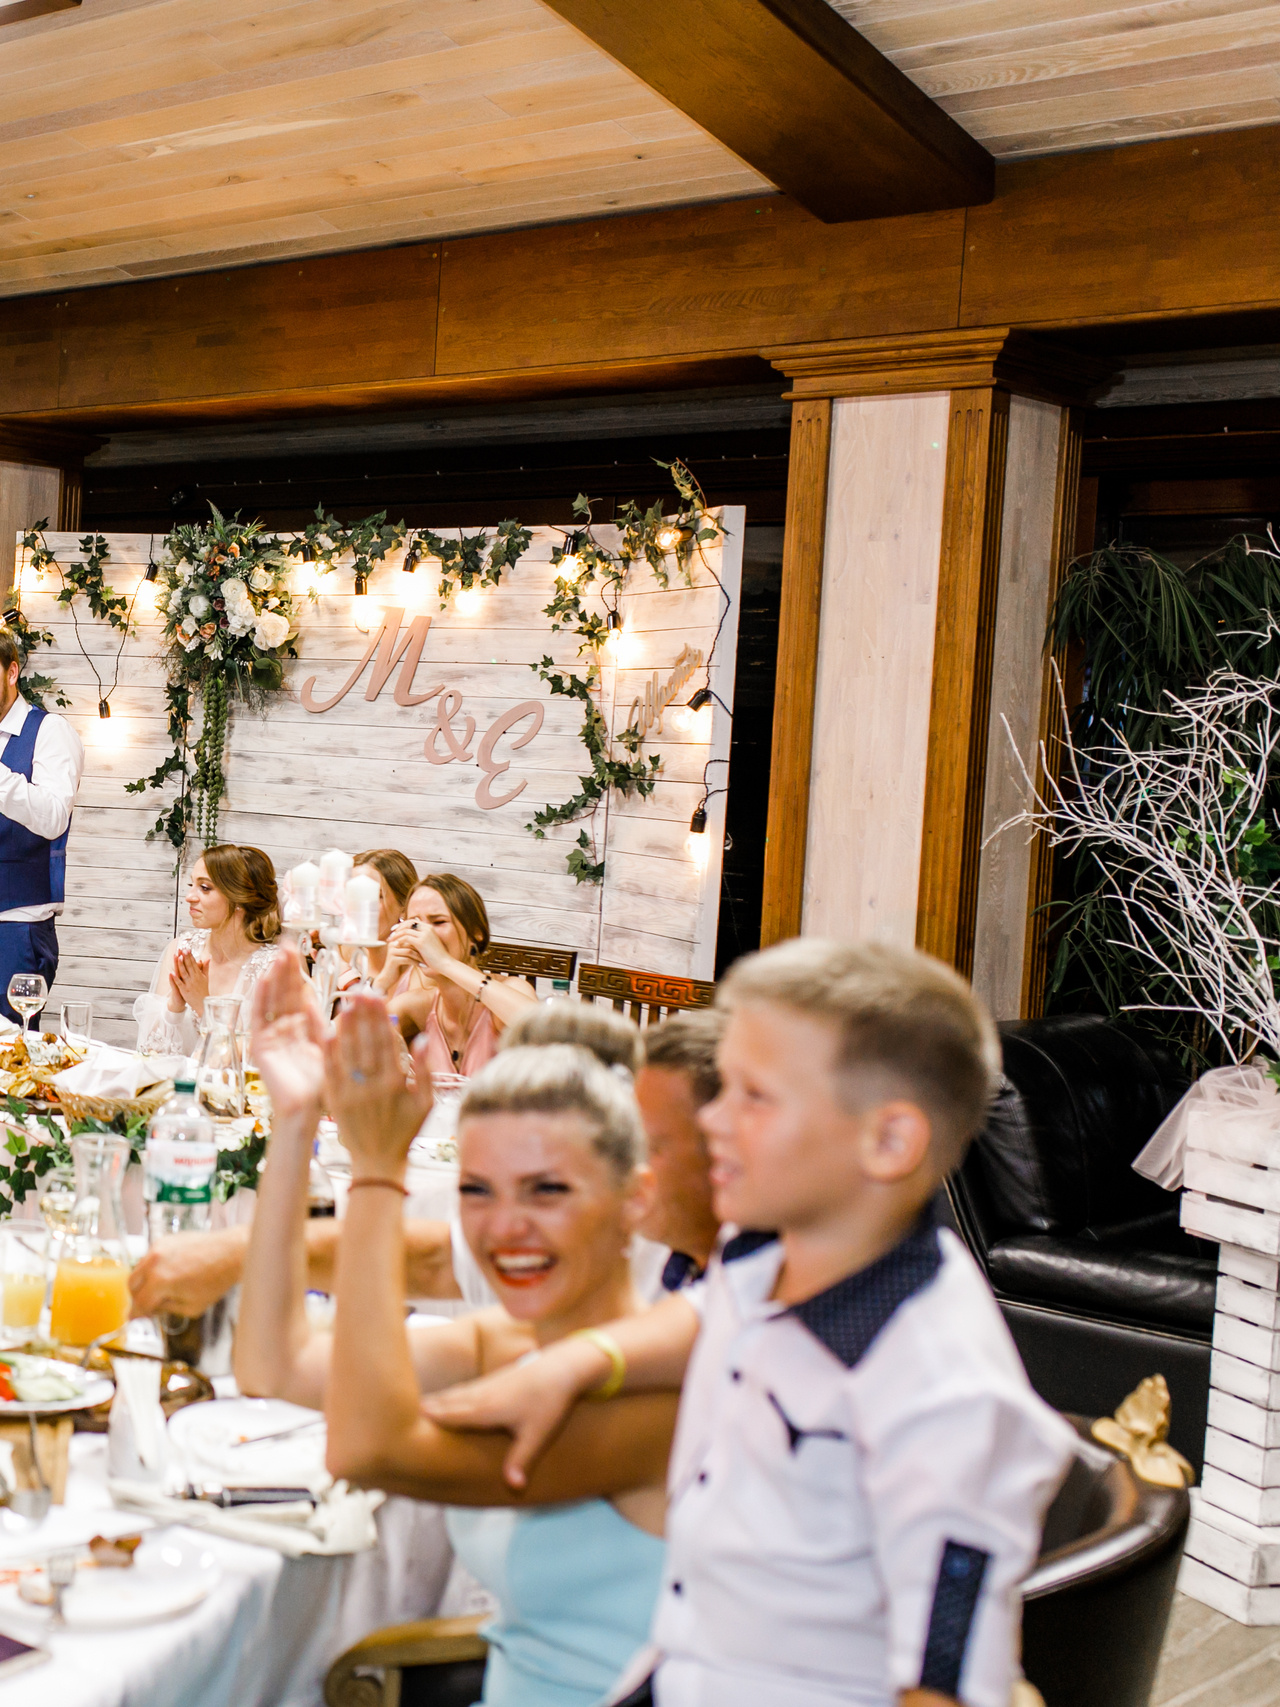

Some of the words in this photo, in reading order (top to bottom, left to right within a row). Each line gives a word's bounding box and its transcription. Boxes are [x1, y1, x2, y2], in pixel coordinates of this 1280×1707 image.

[300, 606, 445, 713] M
[424, 690, 475, 765] &
[475, 701, 545, 810] E
